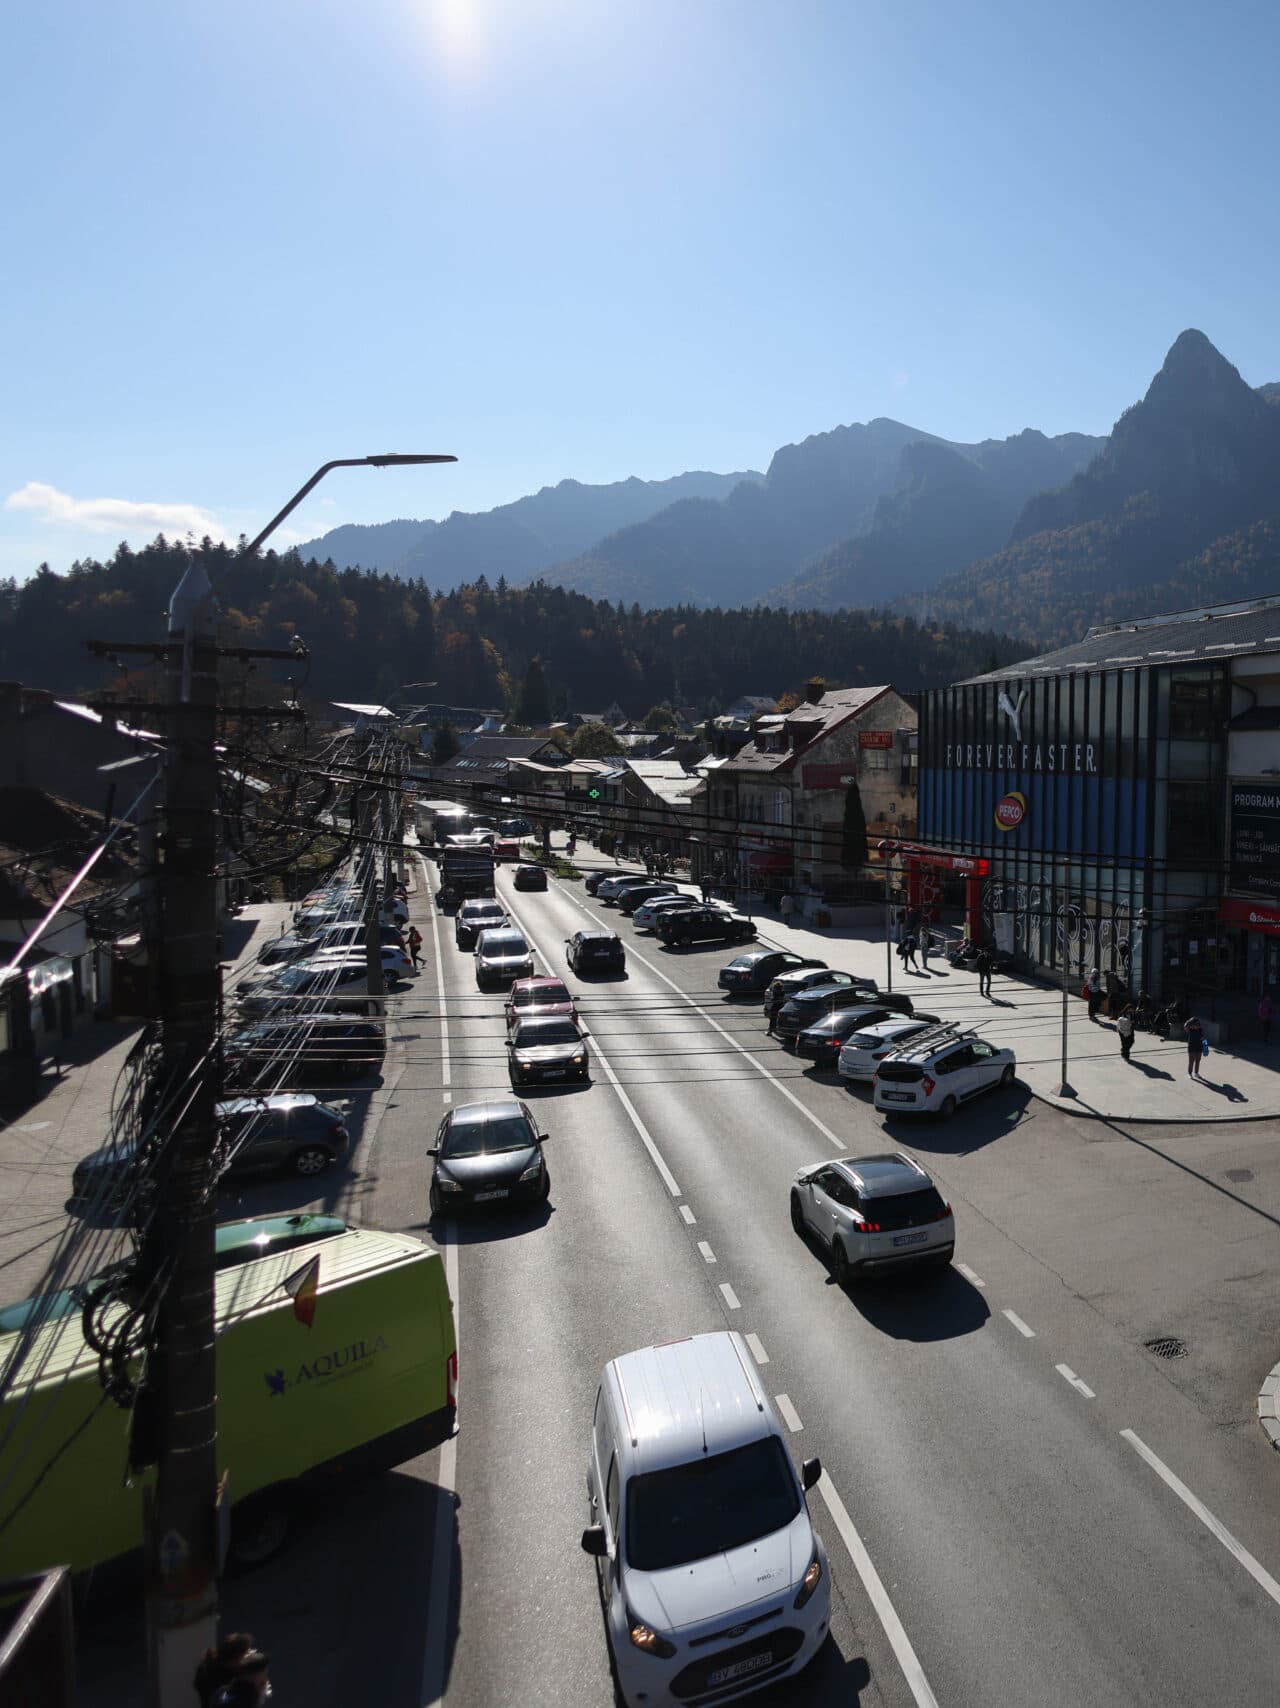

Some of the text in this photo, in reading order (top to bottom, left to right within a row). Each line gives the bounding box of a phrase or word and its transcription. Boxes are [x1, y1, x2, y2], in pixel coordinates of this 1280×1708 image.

[946, 744, 1097, 772] FOREVER. FASTER.
[1234, 793, 1274, 808] PROGRAM
[998, 805, 1020, 819] PEPCO
[296, 1336, 389, 1385] AQUILA
